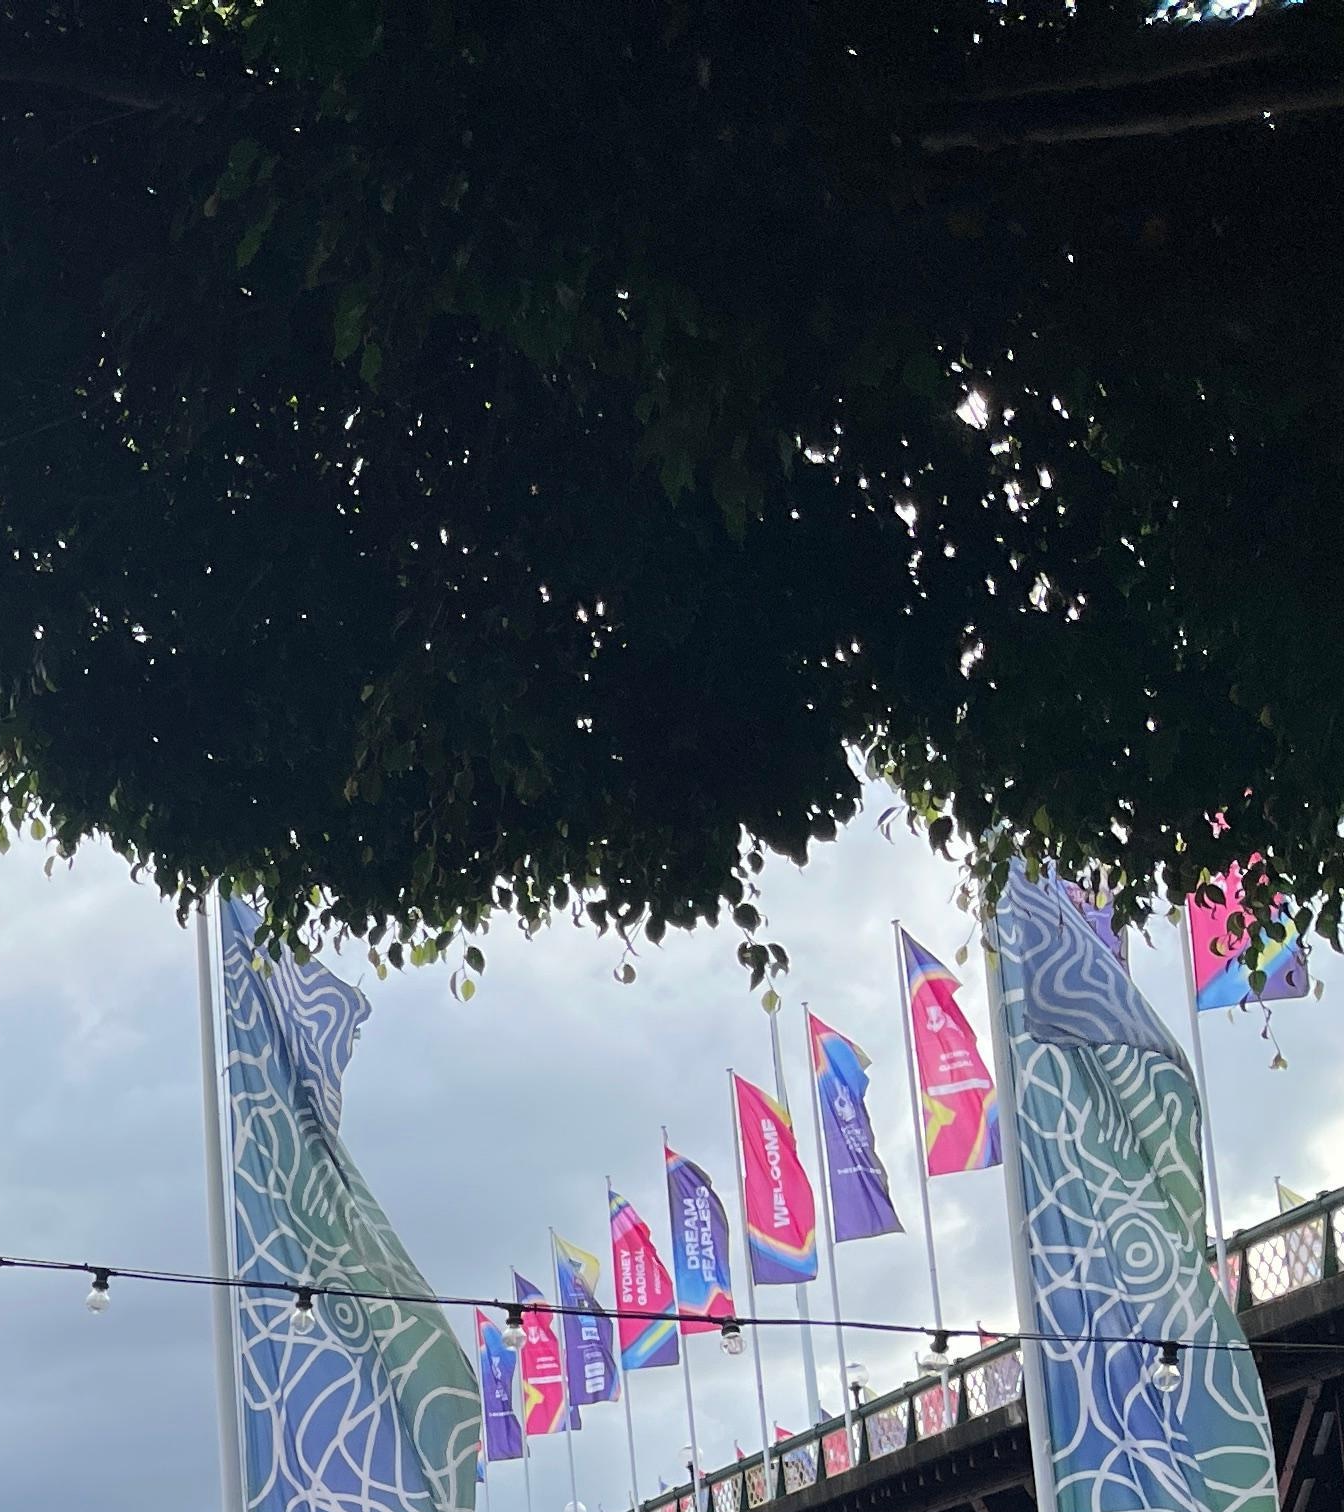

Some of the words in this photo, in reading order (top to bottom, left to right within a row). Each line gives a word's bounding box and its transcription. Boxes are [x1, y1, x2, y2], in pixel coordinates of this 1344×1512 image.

[761, 1119, 791, 1229] WELCOME
[683, 1198, 700, 1270] DREAM
[696, 1185, 717, 1282] FEARLESS
[620, 1249, 633, 1303] SYDNEY
[634, 1247, 647, 1306] GADIGAL
